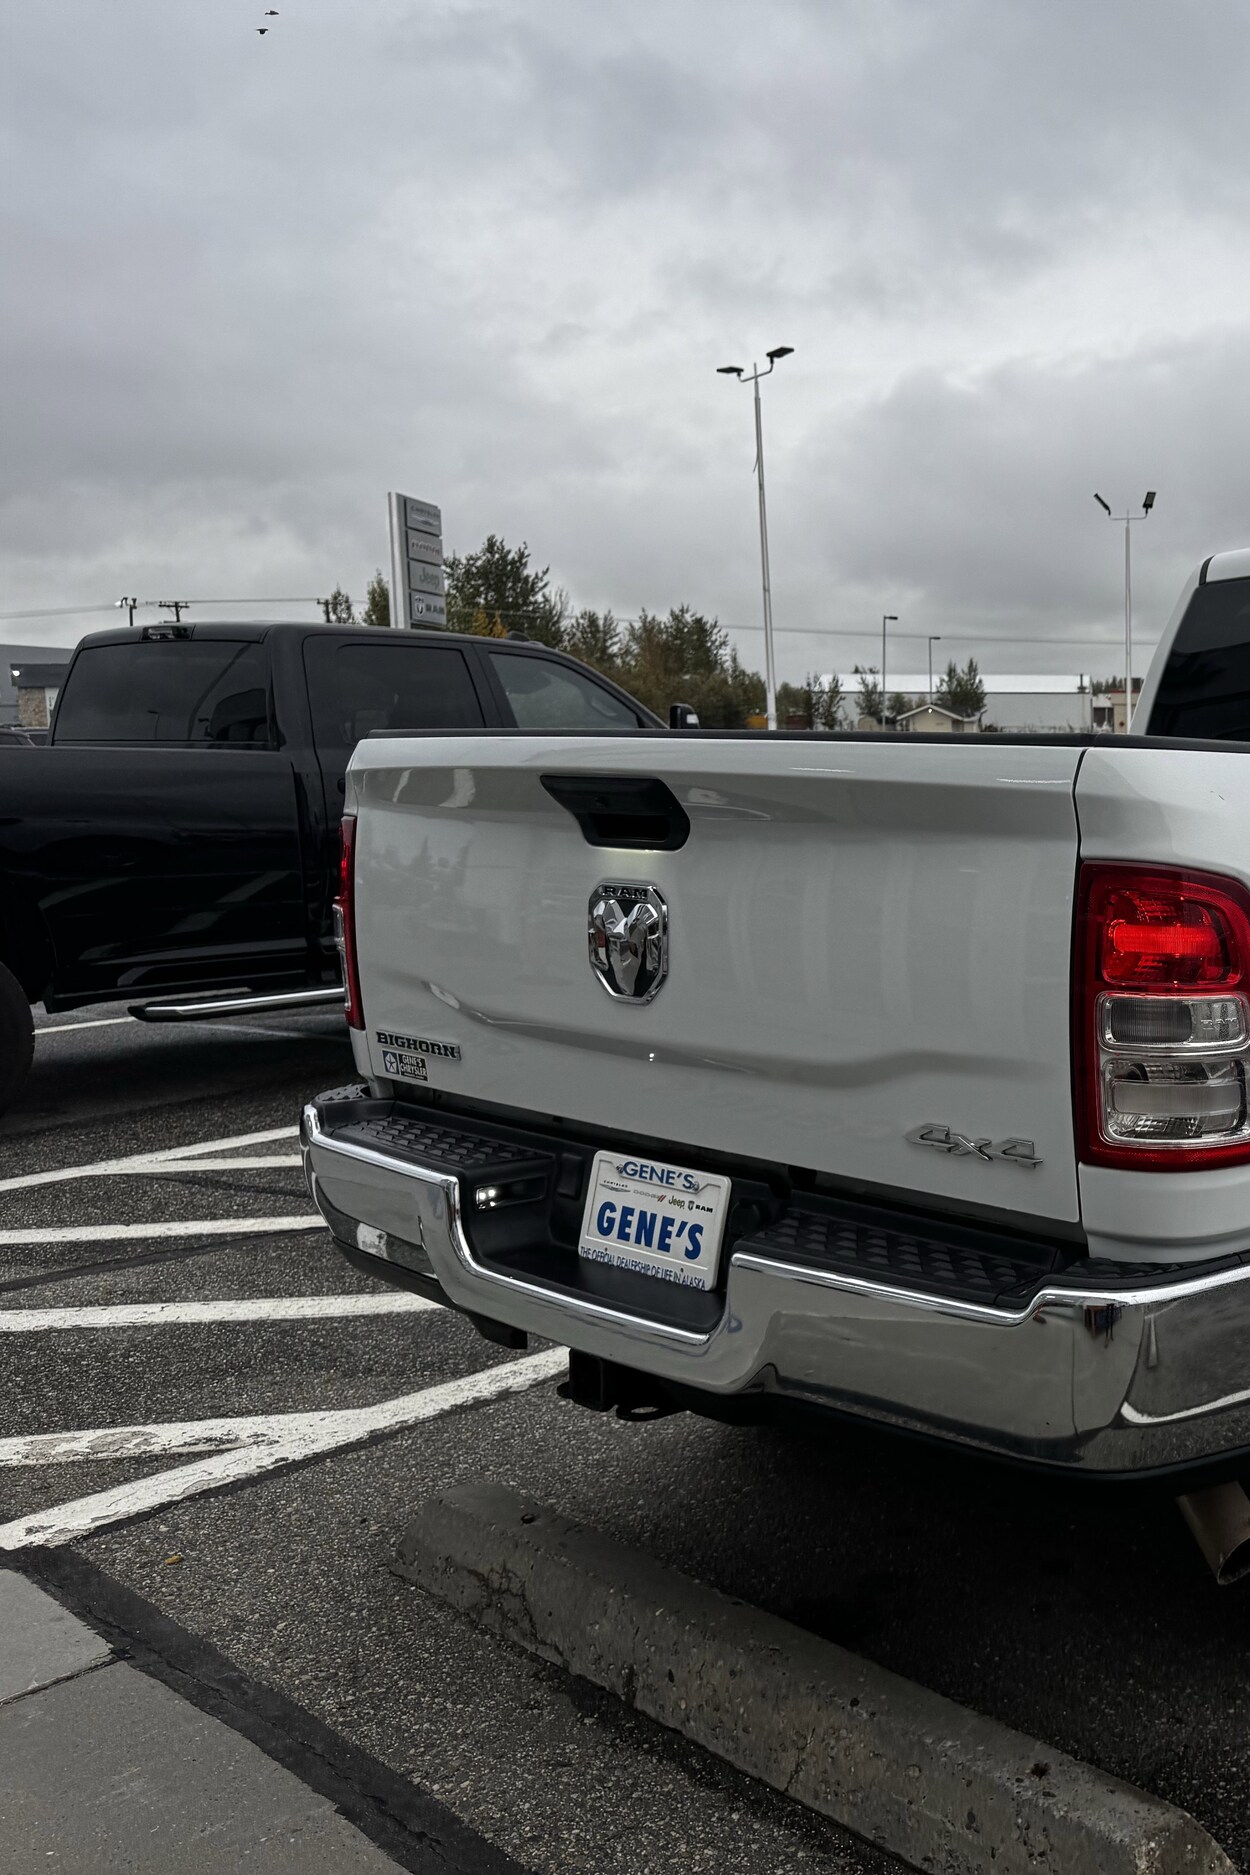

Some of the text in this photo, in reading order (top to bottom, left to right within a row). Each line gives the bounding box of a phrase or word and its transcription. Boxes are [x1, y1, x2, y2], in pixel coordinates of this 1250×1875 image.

[602, 886, 648, 899] RAM
[376, 1031, 457, 1058] BIGHORN
[400, 1063, 427, 1076] CHRYSLER
[623, 1161, 695, 1190] GENE'S
[668, 1195, 685, 1209] Jeep
[695, 1205, 713, 1213] RAM
[597, 1201, 704, 1260] GENE'S
[580, 1246, 592, 1259] THE
[591, 1249, 616, 1265] OFFICIAL
[617, 1257, 651, 1276] DEALERSHIP
[651, 1265, 660, 1278] OF
[682, 1274, 706, 1290] ALASKA
